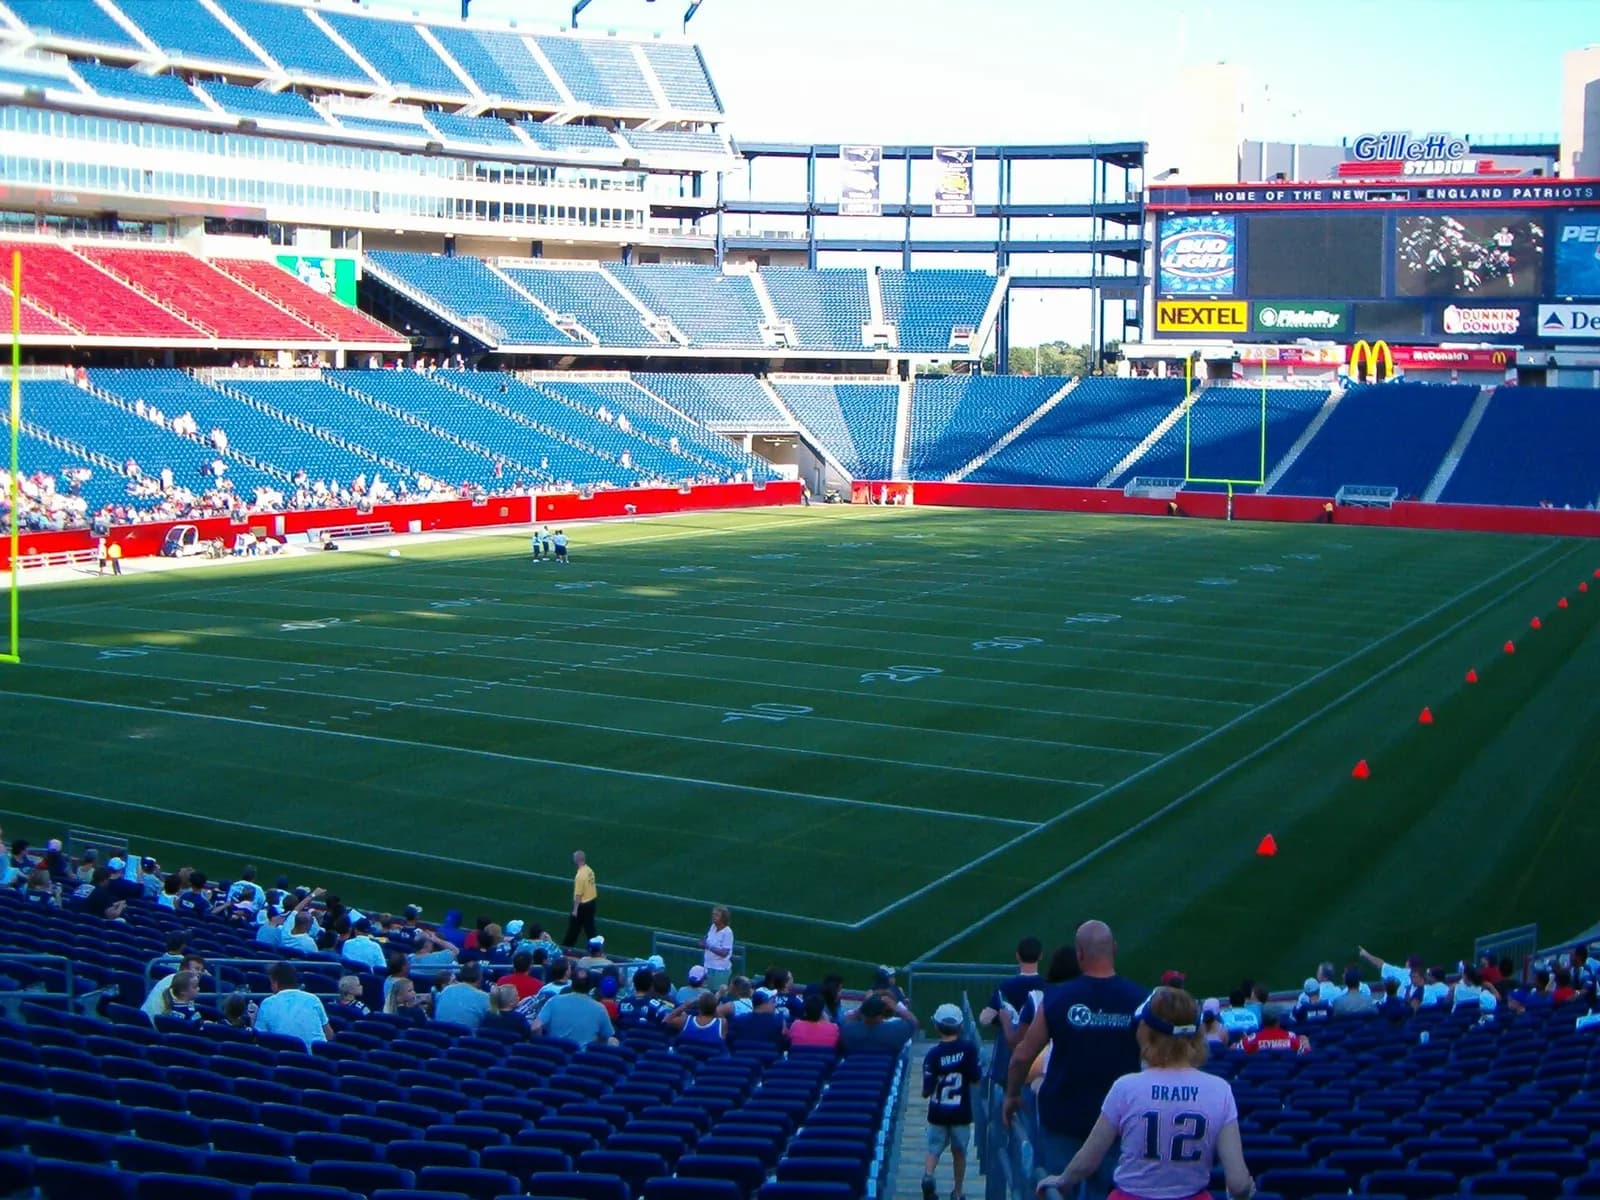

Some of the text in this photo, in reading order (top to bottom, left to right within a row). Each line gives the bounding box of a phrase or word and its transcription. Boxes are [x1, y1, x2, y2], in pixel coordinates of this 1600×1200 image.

[1354, 131, 1467, 161] Gillette
[1404, 160, 1477, 174] STADIUM
[1214, 187, 1593, 201] HOME OF THE NEW ENGLAND PATRIOTS
[1561, 225, 1600, 242] PE
[1175, 239, 1228, 255] BUD
[1161, 253, 1235, 269] LIGHT
[1160, 307, 1244, 325] NEXTEL
[1277, 309, 1340, 328] Fidelity
[1461, 321, 1515, 332] DONUTS
[1413, 351, 1470, 361] McDonald's
[860, 665, 943, 683] 20
[723, 703, 813, 723] 10
[1151, 1085, 1199, 1101] BRADY
[1141, 1109, 1208, 1161] 12
